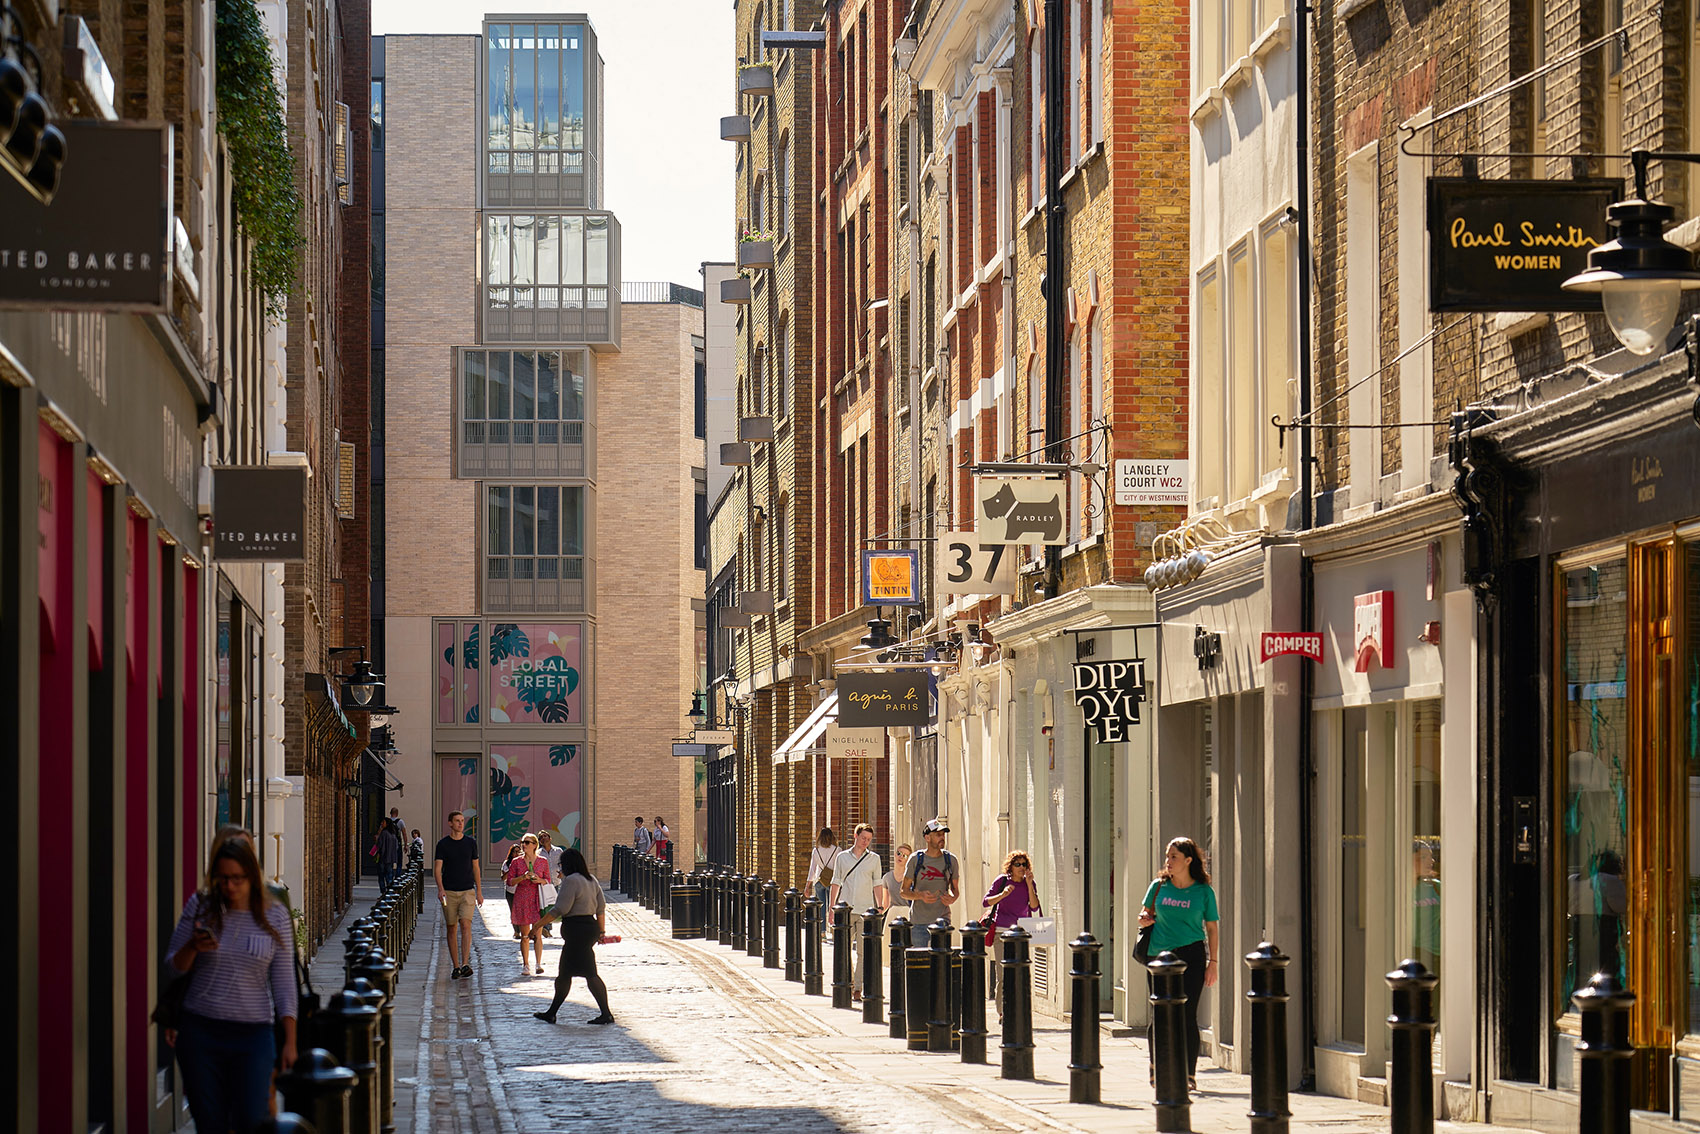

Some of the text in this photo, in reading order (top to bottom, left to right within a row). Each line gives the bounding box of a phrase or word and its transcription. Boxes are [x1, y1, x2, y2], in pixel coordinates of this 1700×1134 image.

[1450, 217, 1603, 248] Paul Smith
[2, 250, 151, 270] TED BAKER
[1494, 255, 1561, 270] WOMEN
[40, 277, 110, 288] LONDON
[1123, 465, 1169, 475] LANGLEY
[1123, 477, 1182, 487] COURT WC2
[220, 532, 297, 542] TED BAKER
[947, 542, 1006, 584] 37
[874, 586, 908, 595] TINTIN
[1265, 636, 1320, 657] CAMPER
[500, 660, 568, 672] FLORAL
[500, 675, 568, 688] STREET
[885, 703, 919, 712] PARIS
[1162, 897, 1191, 909] Merci
